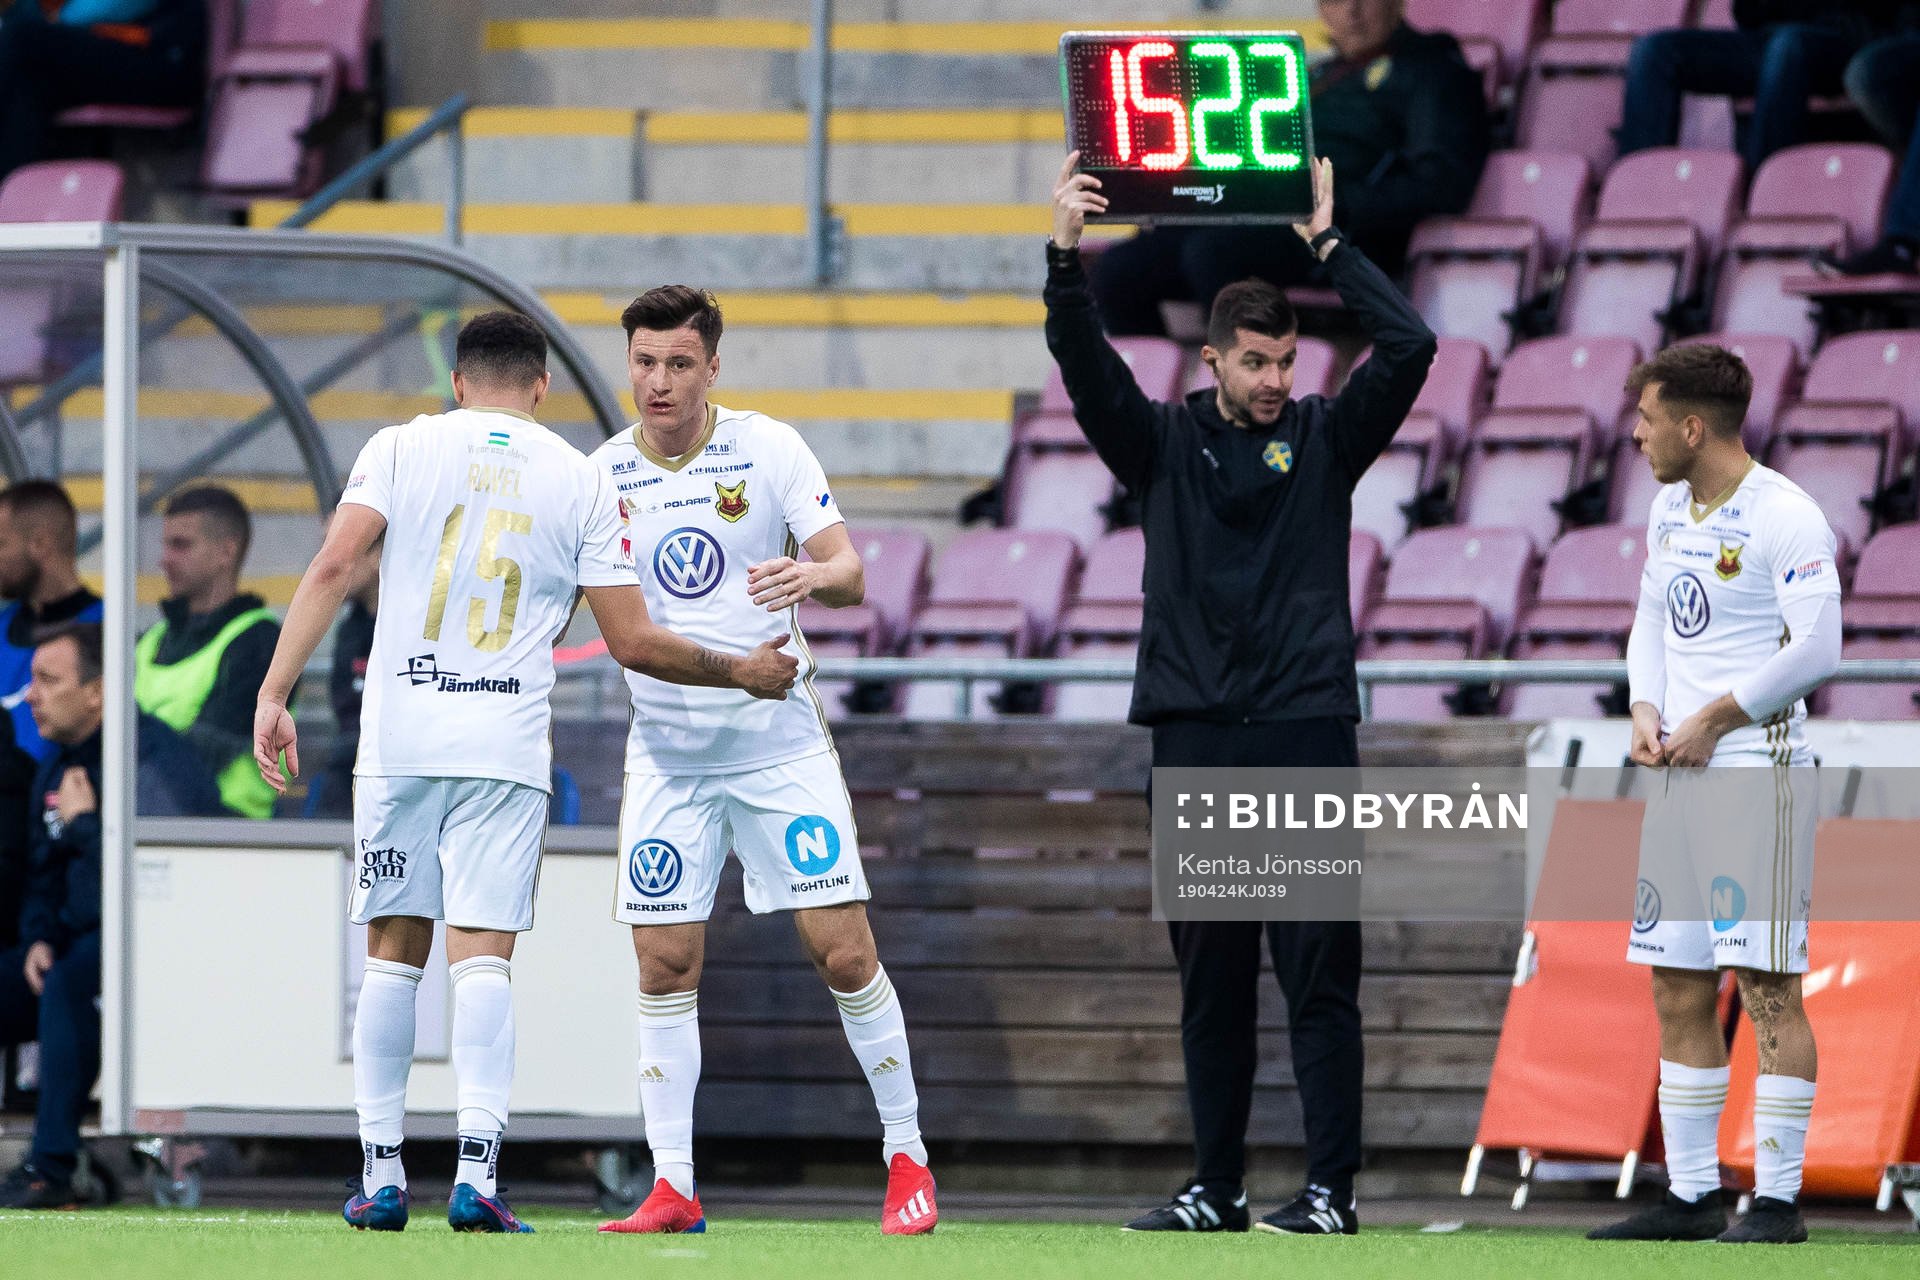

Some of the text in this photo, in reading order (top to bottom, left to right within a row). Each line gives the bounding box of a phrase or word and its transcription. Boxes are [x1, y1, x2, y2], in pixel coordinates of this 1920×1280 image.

[1110, 43, 1301, 169] 15 22
[626, 460, 637, 470] AB
[468, 464, 523, 500] RAVEL
[664, 496, 713, 510] POLARIS
[423, 503, 534, 654] 15
[437, 676, 521, 695] Jämtkraft
[359, 863, 405, 889] gym
[791, 874, 850, 893] NIGHTLINE
[626, 902, 687, 912] BERNERS
